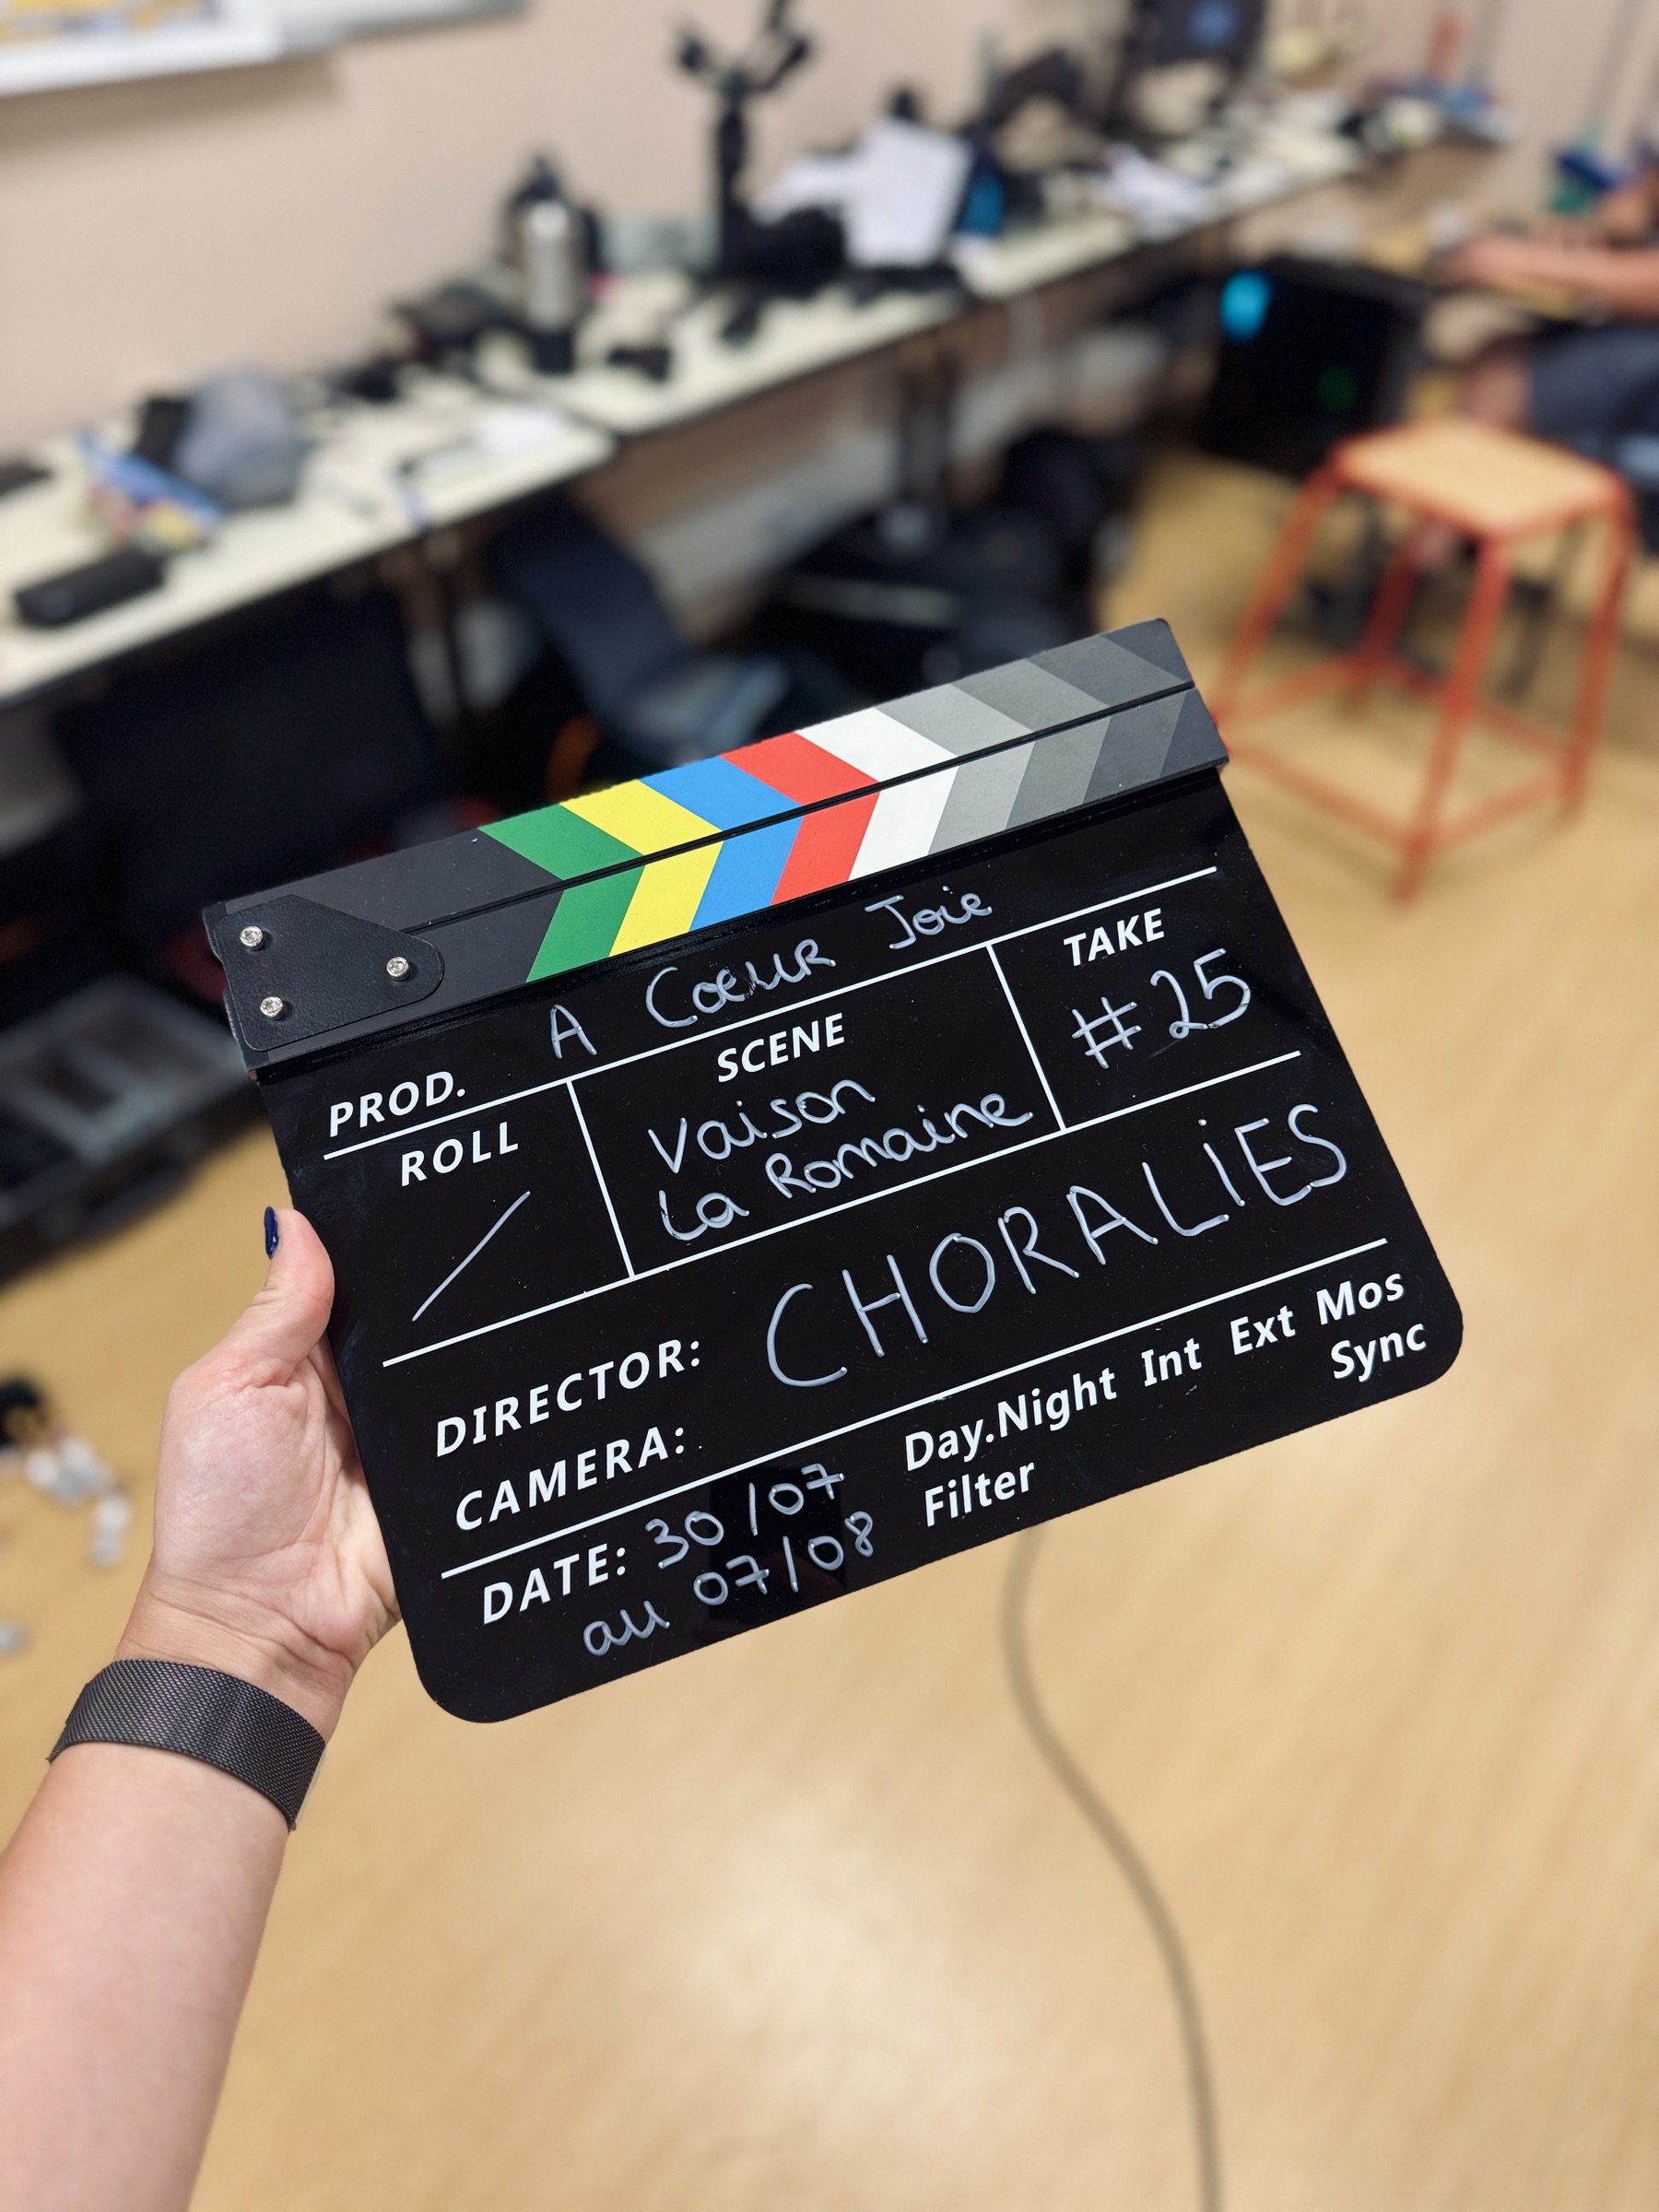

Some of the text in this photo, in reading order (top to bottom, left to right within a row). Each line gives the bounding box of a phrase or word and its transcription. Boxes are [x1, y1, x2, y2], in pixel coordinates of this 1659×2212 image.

[551, 1004, 598, 1059] A
[864, 885, 993, 950] Joie
[1063, 907, 1165, 967] TAKE
[717, 1012, 845, 1083] SCENE
[329, 1071, 466, 1138] PROD.
[647, 1079, 877, 1174] Vaison
[764, 1093, 1034, 1199] Romaine
[401, 1121, 519, 1187] ROLL
[1140, 1337, 1203, 1387] Int
[1230, 1305, 1297, 1356] Ext
[1315, 1273, 1405, 1325] Mos
[1330, 1323, 1427, 1382] Sync
[436, 1339, 700, 1458] DIRECTOR:
[455, 1426, 685, 1531] CAMERA:
[924, 1462, 1035, 1527] Filter
[483, 1547, 626, 1625] DATE:
[582, 1511, 874, 1655] au 07/08
